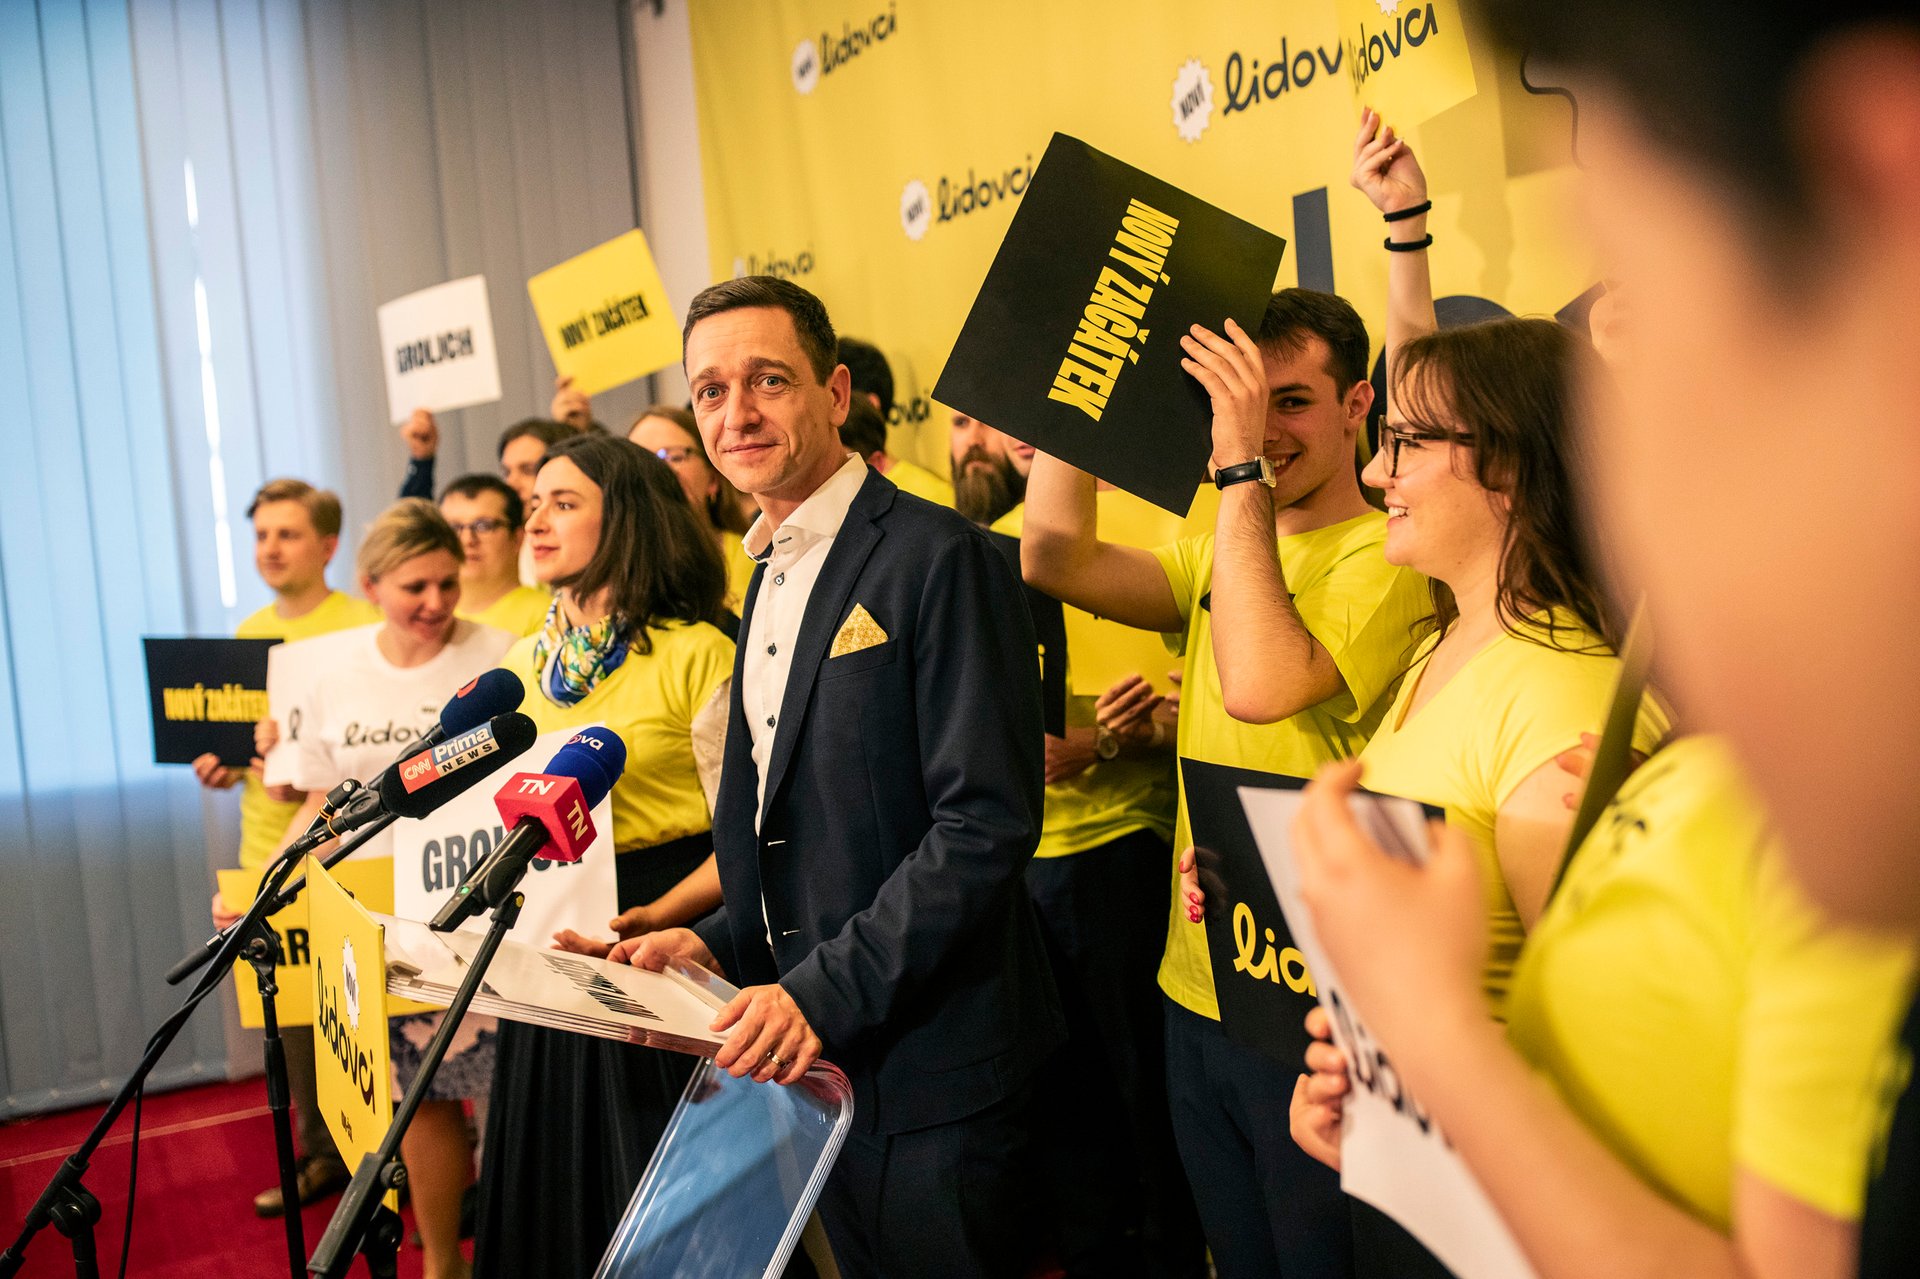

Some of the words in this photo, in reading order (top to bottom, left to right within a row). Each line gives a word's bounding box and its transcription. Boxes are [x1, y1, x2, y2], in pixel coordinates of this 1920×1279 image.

[1222, 36, 1343, 116] lidov
[936, 153, 1033, 223] lidovci
[1108, 197, 1180, 286] NOVÝ
[1047, 265, 1154, 422] ZAČÁTEK
[404, 758, 432, 781] CNN
[434, 727, 491, 763] Prima
[442, 743, 494, 773] NEWS
[518, 778, 555, 795] TN
[567, 799, 589, 842] TN
[317, 956, 376, 1116] lidovci
